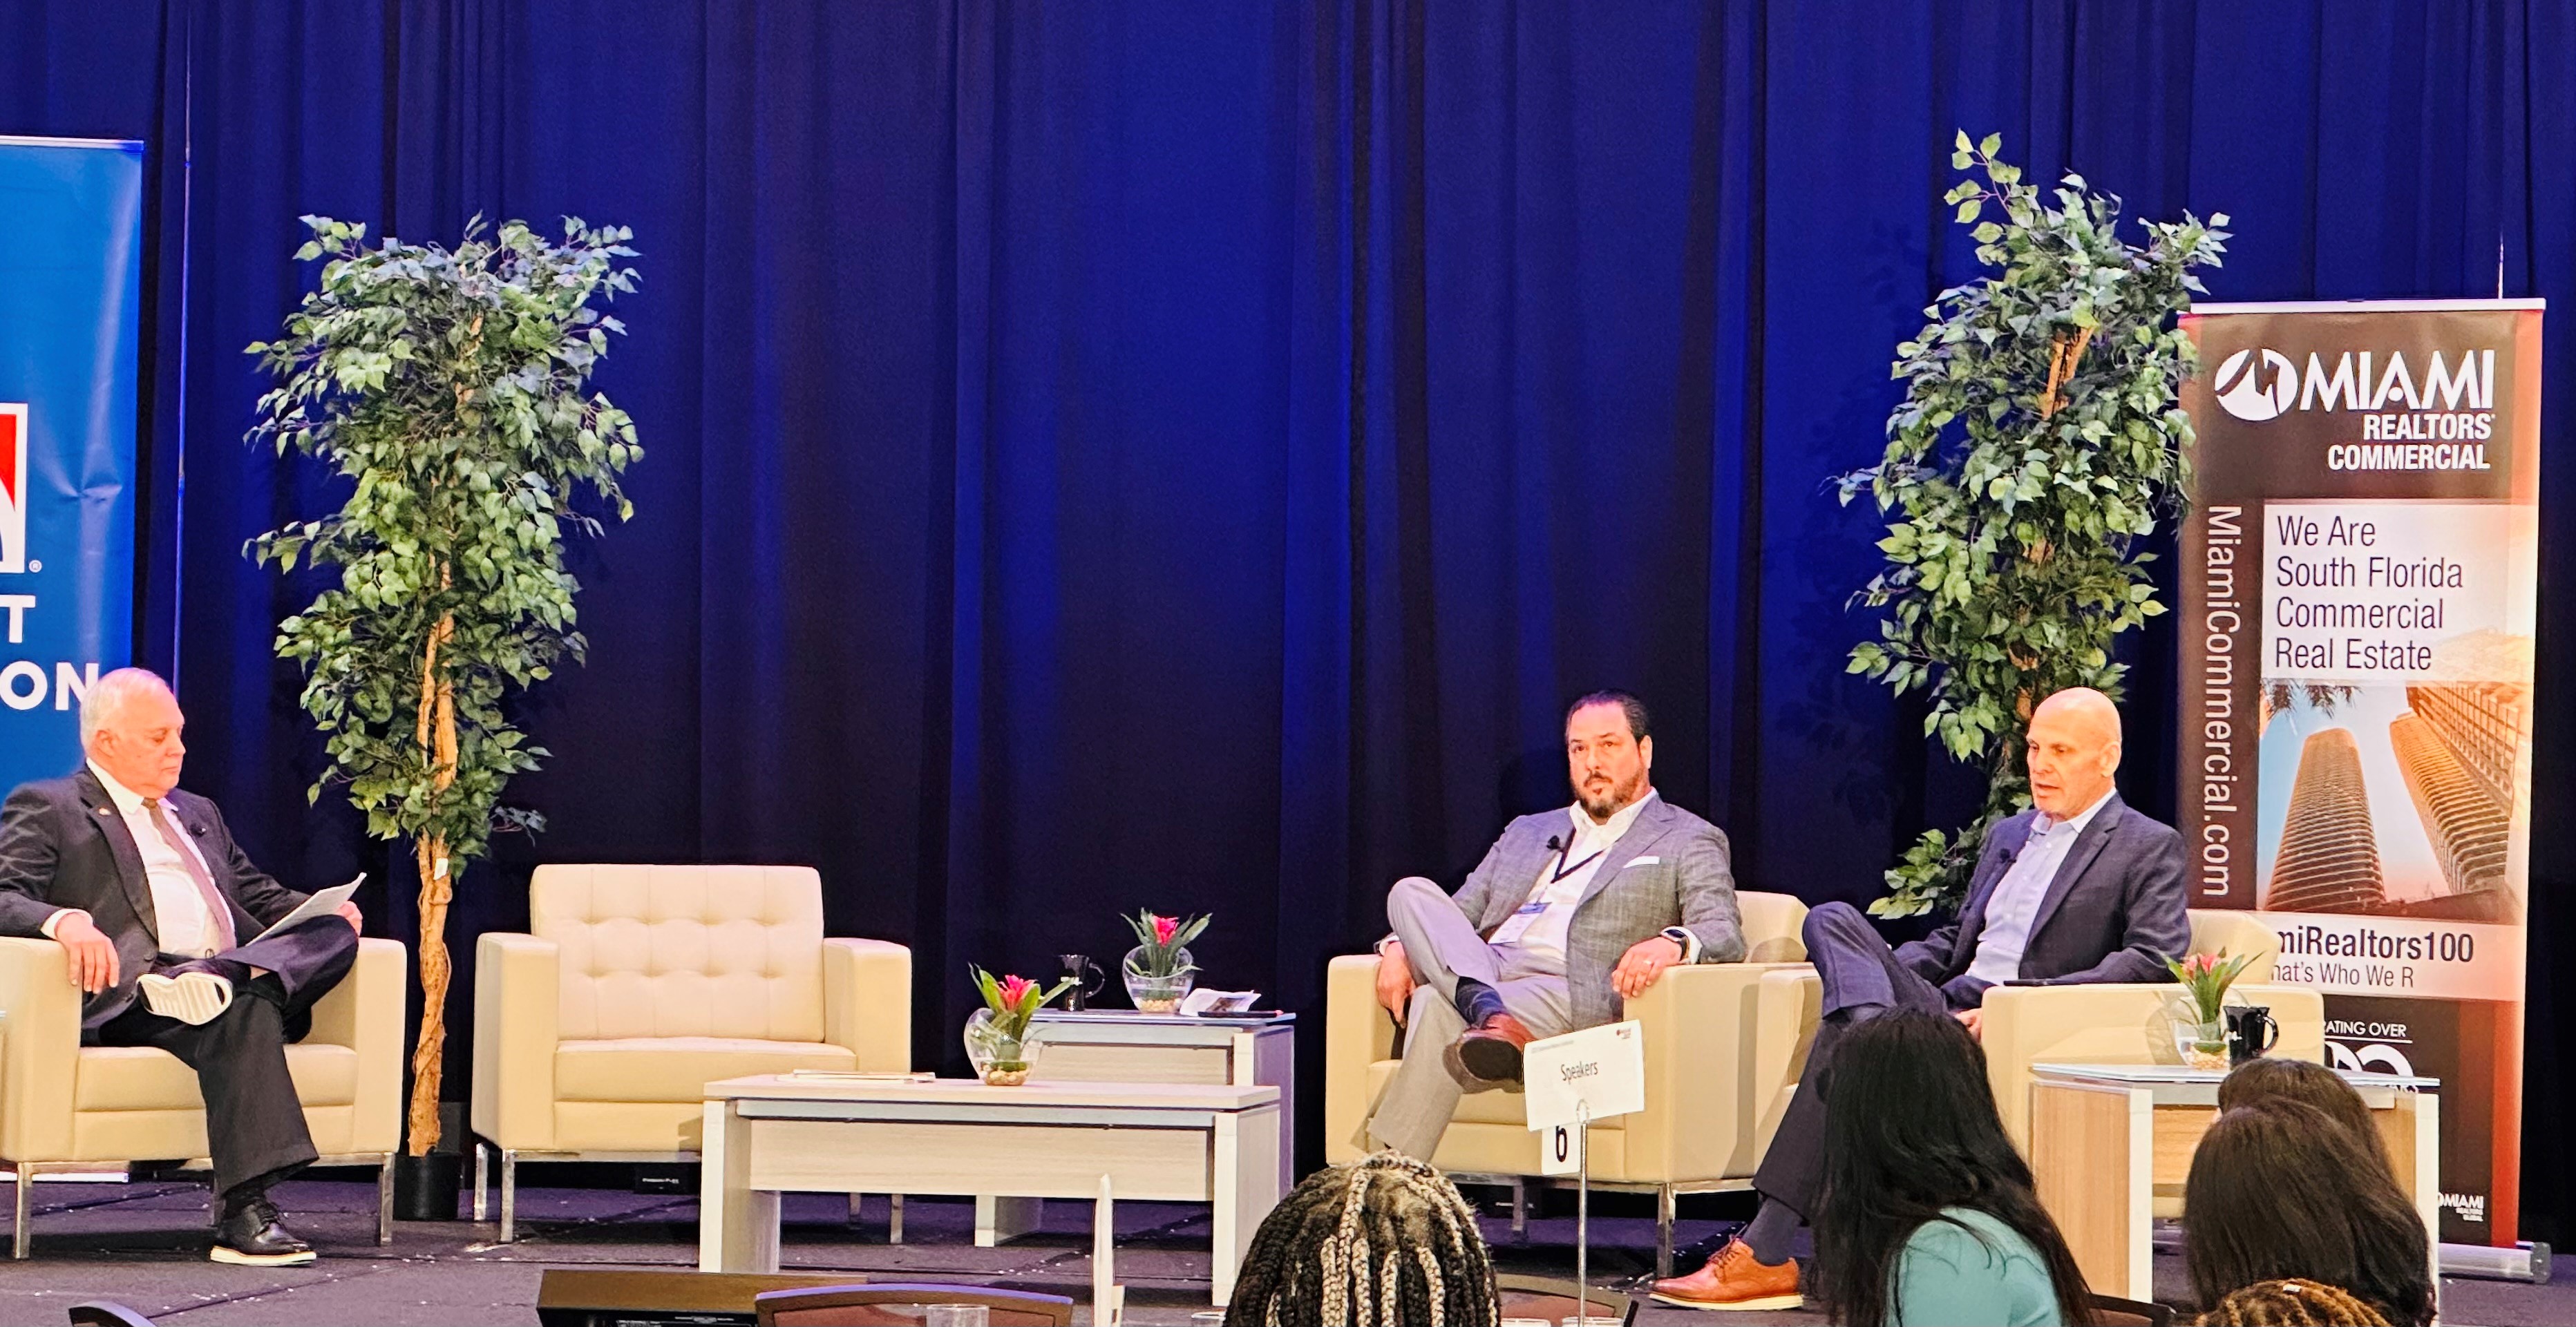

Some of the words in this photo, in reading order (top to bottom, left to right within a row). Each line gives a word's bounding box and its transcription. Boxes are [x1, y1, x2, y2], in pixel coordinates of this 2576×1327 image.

[2299, 350, 2495, 412] MIAMI
[2328, 444, 2490, 470] COMMERCIAL
[2277, 515, 2318, 546] We
[2328, 515, 2376, 546] Are
[2277, 555, 2356, 588] South
[2369, 557, 2463, 589] Florida
[2276, 596, 2443, 629] Commercial
[2275, 638, 2333, 669] Real
[2347, 639, 2432, 670] Estate
[2203, 506, 2242, 897] MiamiCommercial.com
[2320, 963, 2360, 985] Who
[2366, 965, 2394, 986] We
[2401, 967, 2414, 988] R
[2369, 1022, 2407, 1038] OVER
[1560, 1060, 1599, 1085] Speakers
[1555, 1125, 1568, 1163] 6
[2443, 1193, 2484, 1208] MIAMI
